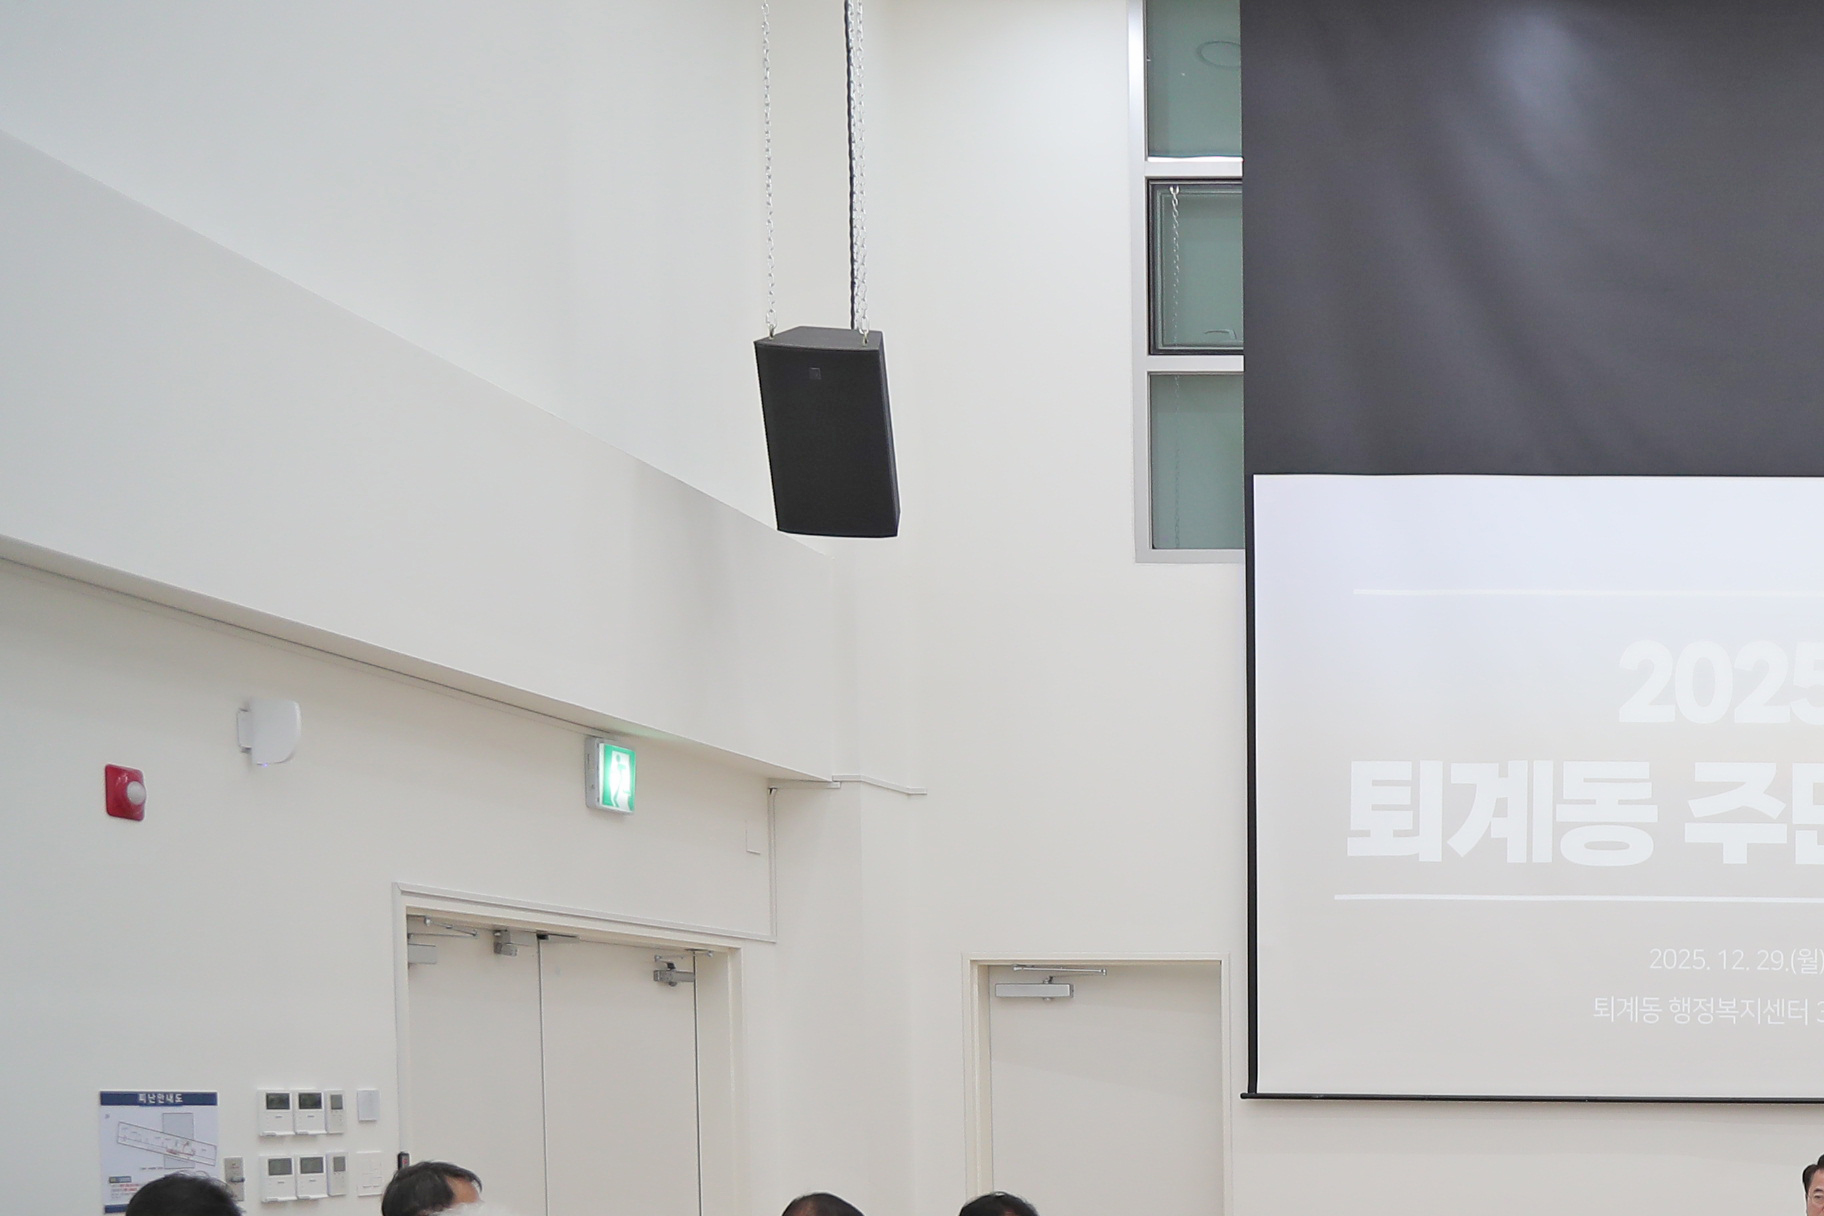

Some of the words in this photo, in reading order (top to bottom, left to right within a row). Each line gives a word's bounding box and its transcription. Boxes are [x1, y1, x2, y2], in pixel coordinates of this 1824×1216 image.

[1346, 760, 1658, 867] 퇴계동
[1649, 948, 1710, 972] 2025.
[1718, 949, 1750, 972] 12.
[1593, 996, 1663, 1025] 퇴계동
[1669, 997, 1809, 1027] 행정복지센터
